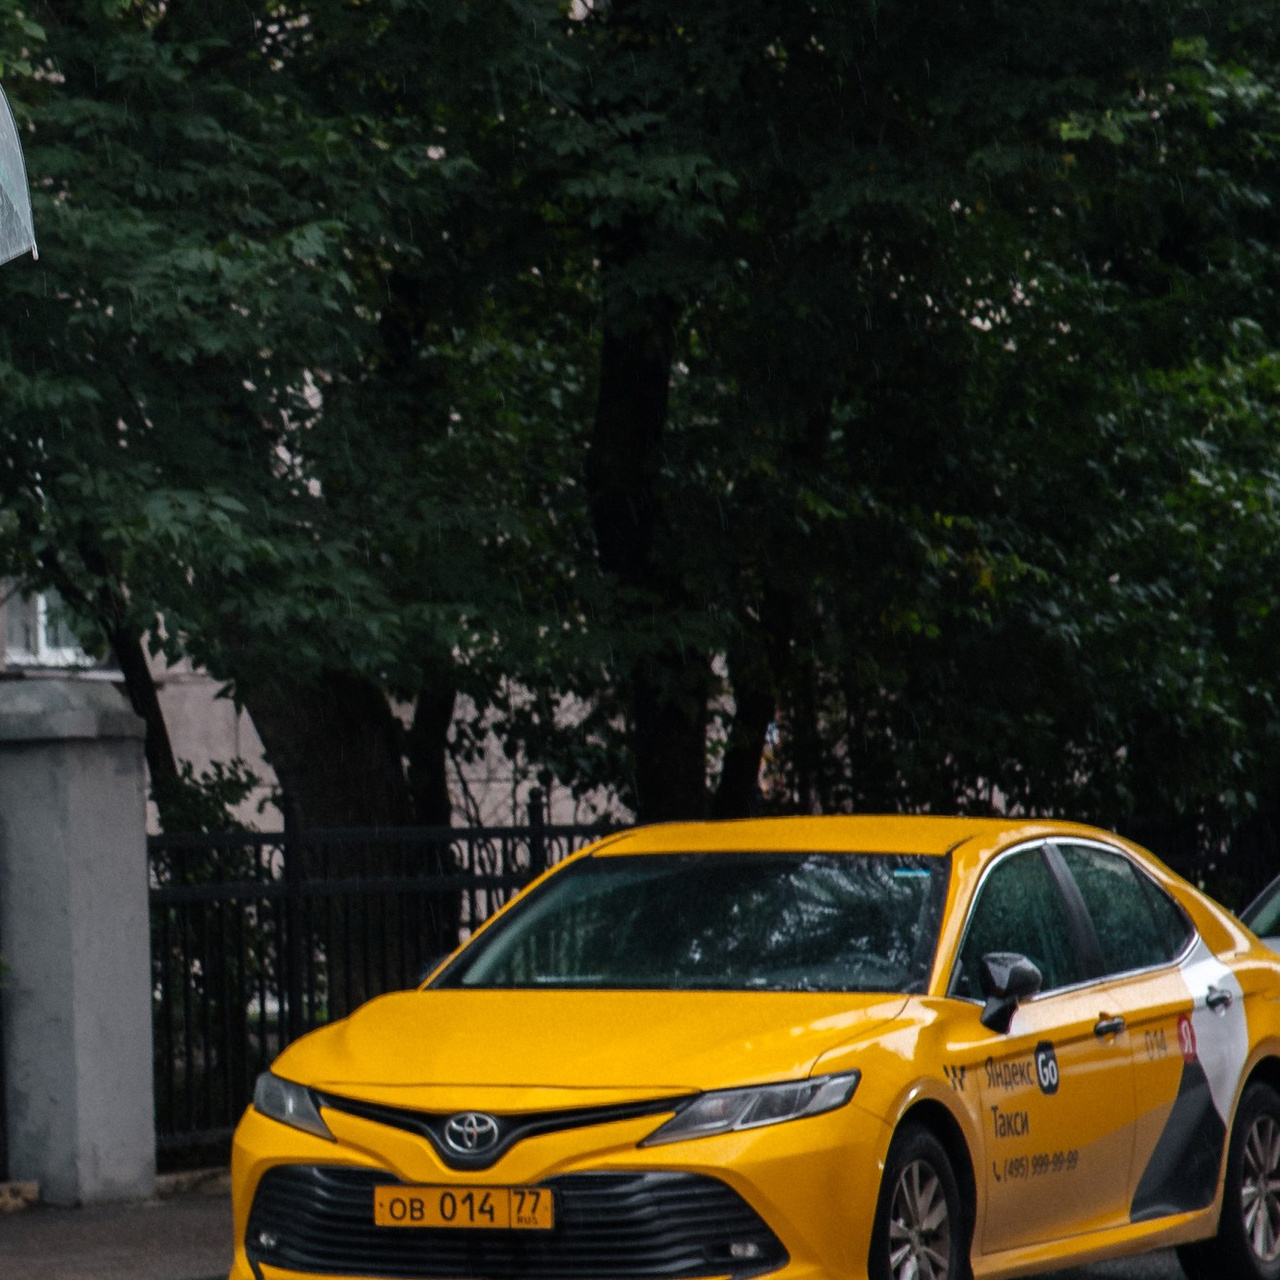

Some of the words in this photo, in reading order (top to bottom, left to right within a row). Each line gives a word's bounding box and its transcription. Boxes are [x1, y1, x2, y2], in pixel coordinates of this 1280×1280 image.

[1144, 1028, 1167, 1060] 014
[984, 1056, 1035, 1091] Яндекс
[1037, 1052, 1059, 1087] Go
[991, 1105, 1030, 1138] Такси
[1003, 1156, 1030, 1182] (495)
[439, 1191, 495, 1223] 014
[513, 1189, 541, 1215] 77
[517, 1215, 539, 1226] RUS
